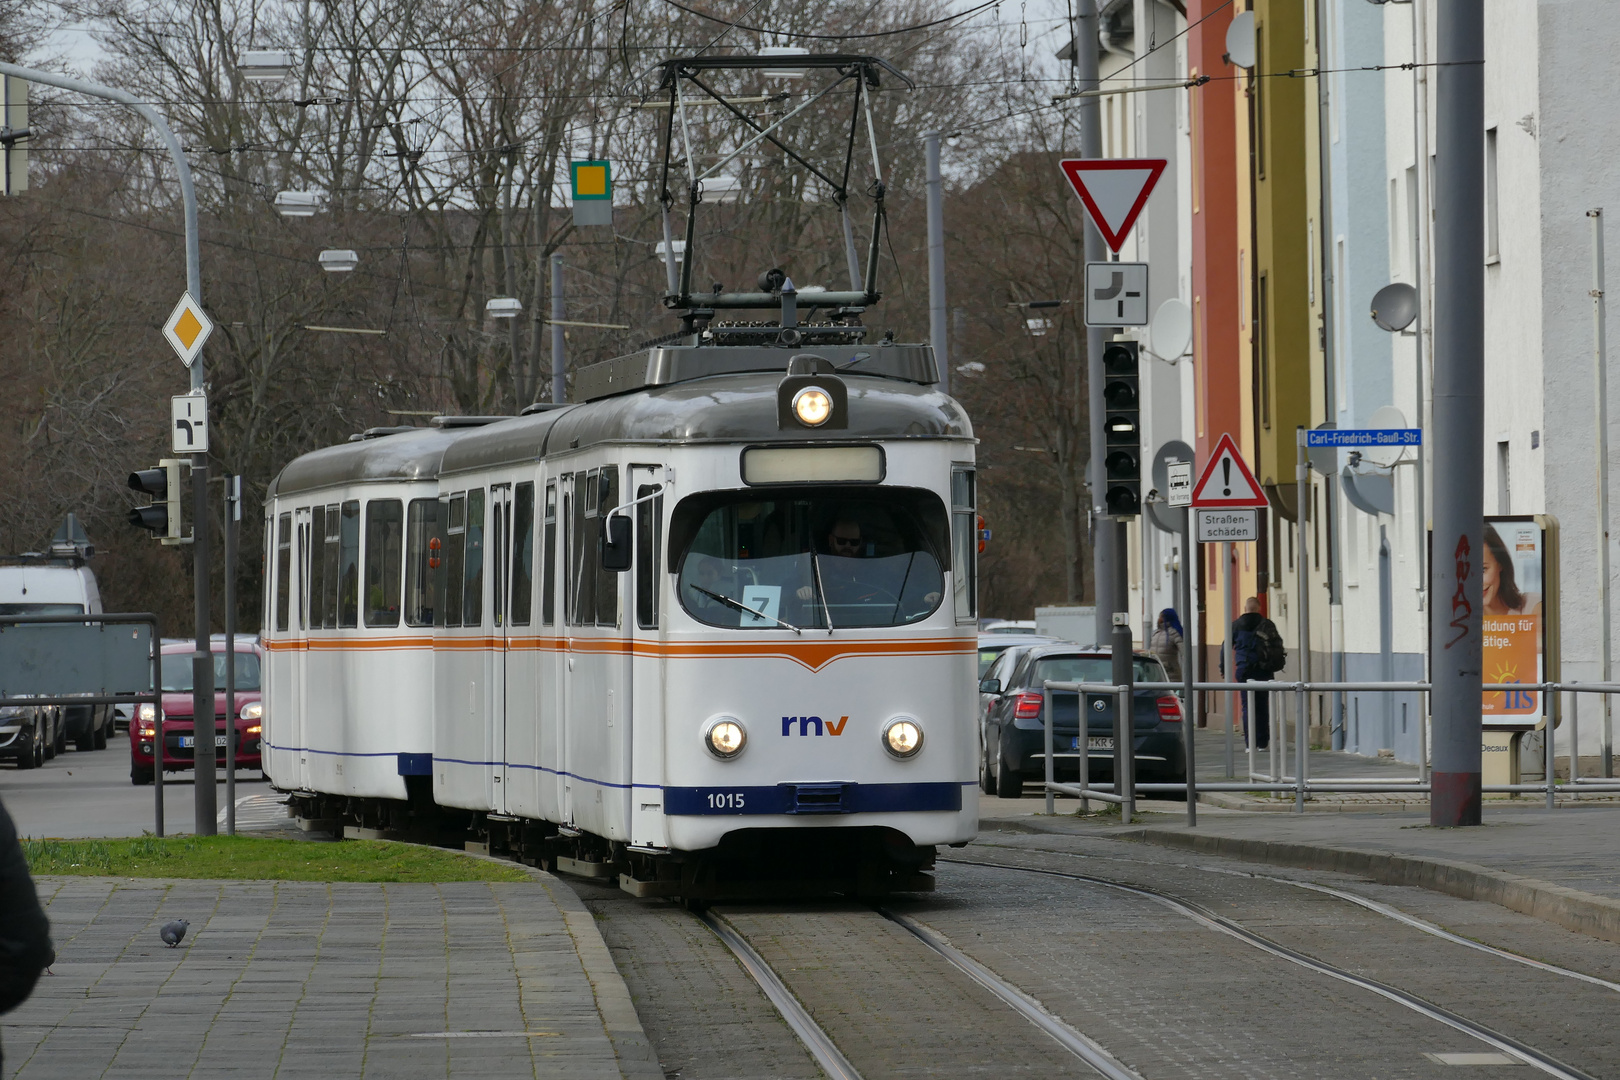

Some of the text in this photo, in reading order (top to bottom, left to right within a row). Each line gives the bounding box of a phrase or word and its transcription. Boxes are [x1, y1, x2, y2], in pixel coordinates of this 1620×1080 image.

[1310, 432, 1420, 444] Carl-Friedrich-Gauß-Str.
[1205, 515, 1250, 524] Straßen-
[1207, 527, 1248, 536] schäden
[752, 597, 770, 622] 7
[1518, 620, 1534, 631] für
[782, 716, 849, 736] rnv
[707, 794, 745, 808] 1015
